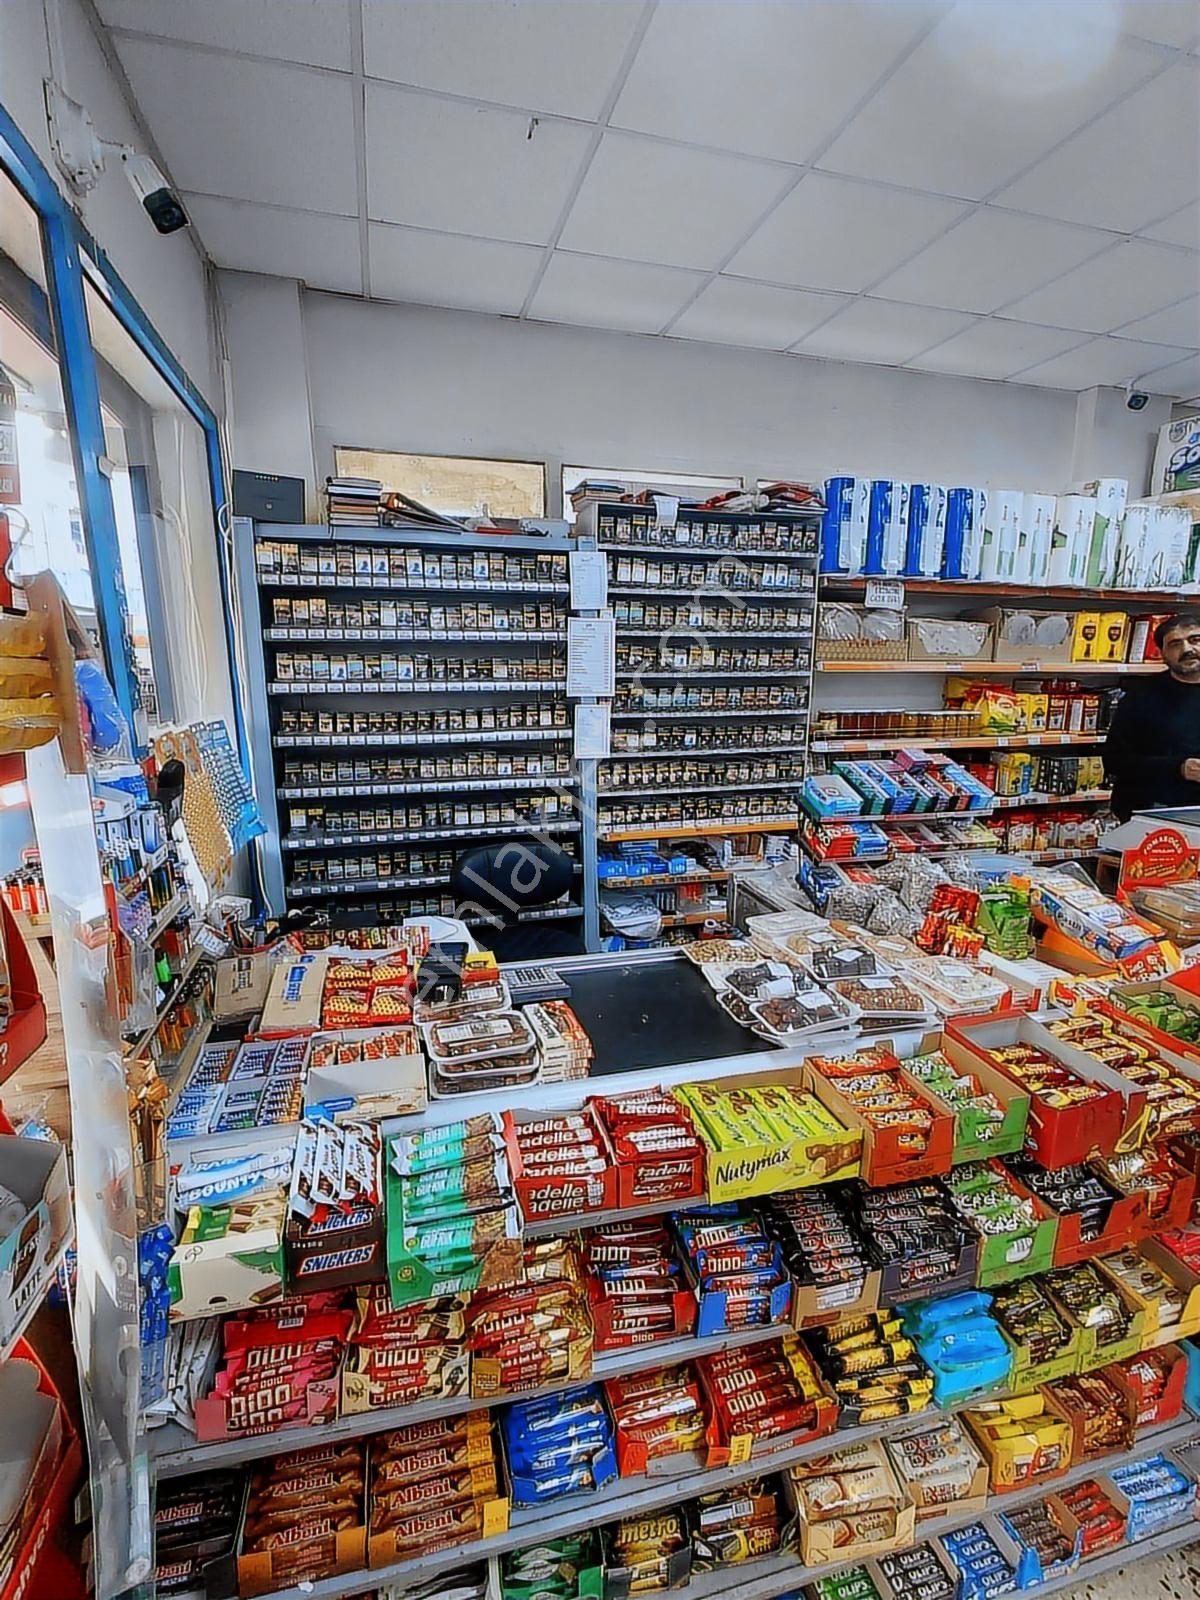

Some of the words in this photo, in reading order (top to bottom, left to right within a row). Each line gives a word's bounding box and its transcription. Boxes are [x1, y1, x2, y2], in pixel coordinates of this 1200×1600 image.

[716, 1148, 792, 1187] Nutymax
[189, 1170, 263, 1201] BOUNTY
[695, 1229, 729, 1249] DIDO
[301, 1245, 374, 1274] SNICKERS
[590, 1246, 631, 1262] DIDO
[707, 1256, 741, 1273] DIDO
[13, 1265, 41, 1312] LATTE
[604, 1278, 646, 1295] DIDO
[375, 1347, 420, 1369] DIDO
[719, 1368, 757, 1394] DIDO
[231, 1384, 291, 1417] DIDO
[729, 1390, 767, 1416] DIDO
[388, 1420, 447, 1449] Albeni
[386, 1448, 448, 1479] Albeni
[273, 1473, 336, 1497] Albeni
[390, 1478, 451, 1510] Albeni
[269, 1518, 332, 1550] Albeni
[395, 1509, 455, 1540] Albeni
[621, 1518, 678, 1544] metro
[838, 1581, 871, 1598] OLIPS
[918, 1579, 951, 1597] OLIPS
